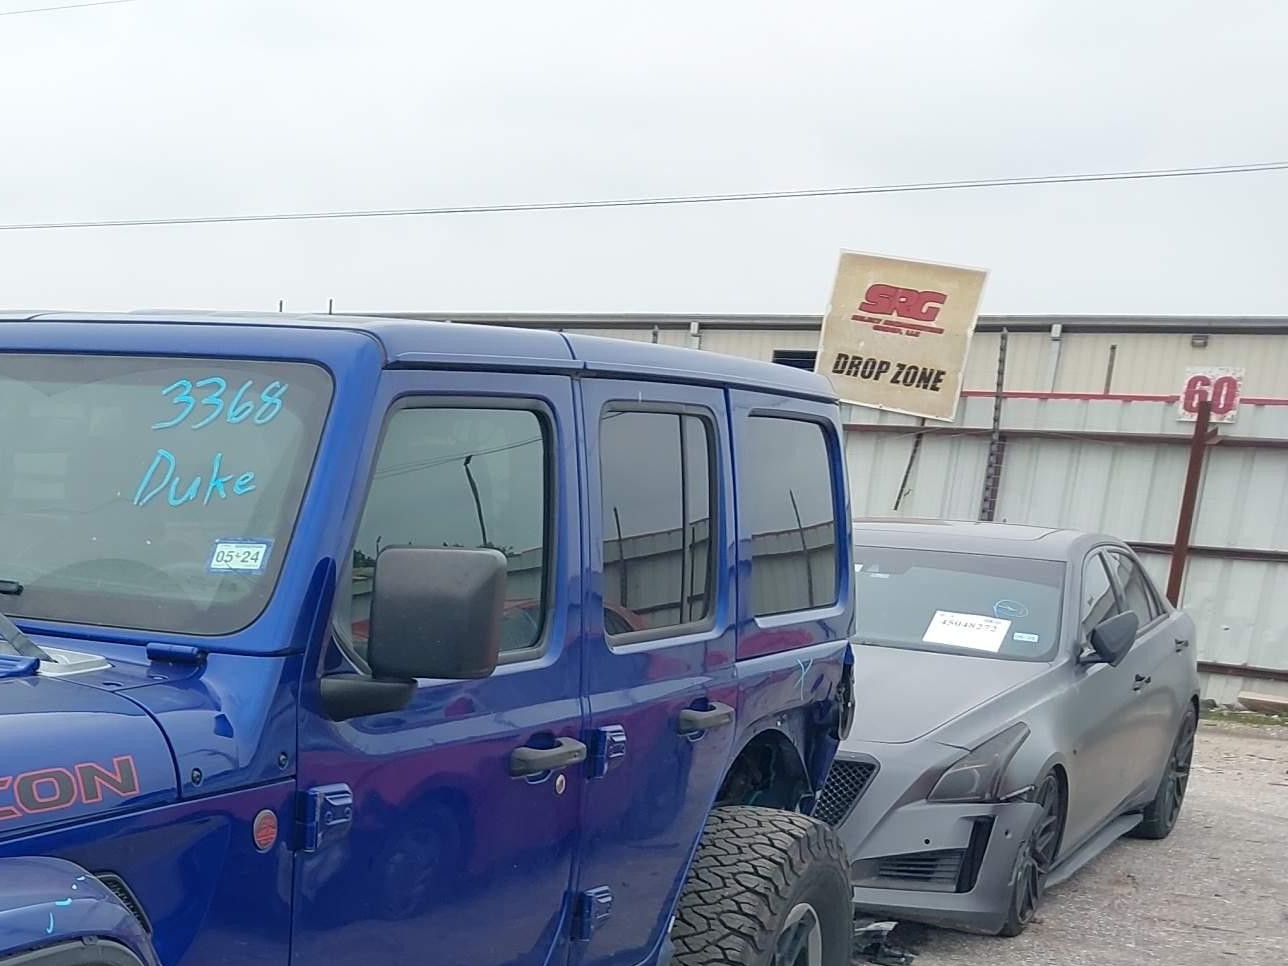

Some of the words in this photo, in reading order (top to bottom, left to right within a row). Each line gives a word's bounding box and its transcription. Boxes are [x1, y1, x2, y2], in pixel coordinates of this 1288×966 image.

[859, 283, 948, 322] SRG
[832, 352, 891, 381] DROP
[890, 363, 947, 392] ZONE
[152, 376, 289, 430] 3368
[1183, 375, 1238, 414] 60
[133, 448, 257, 506] Duke
